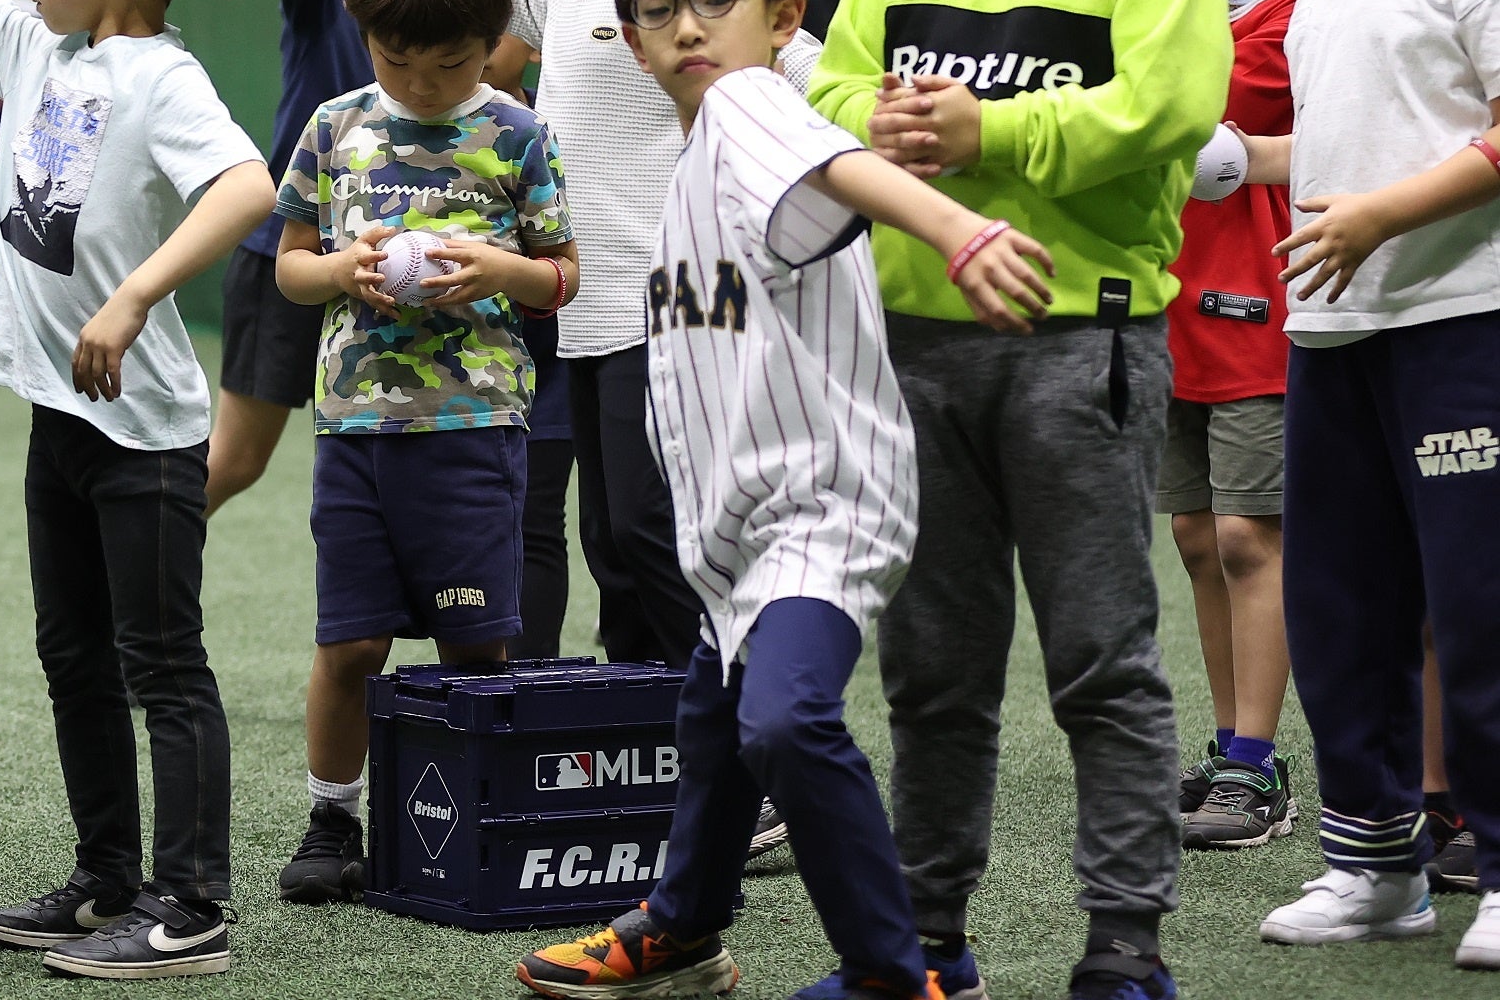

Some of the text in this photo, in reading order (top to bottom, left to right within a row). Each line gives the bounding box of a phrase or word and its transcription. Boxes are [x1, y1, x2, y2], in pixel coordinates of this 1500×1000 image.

[330, 173, 494, 207] Champion
[1414, 427, 1500, 456] STAR
[1416, 446, 1500, 477] WARS
[456, 587, 486, 607] 1969
[596, 746, 680, 787] MLB
[414, 800, 452, 821] Bristol
